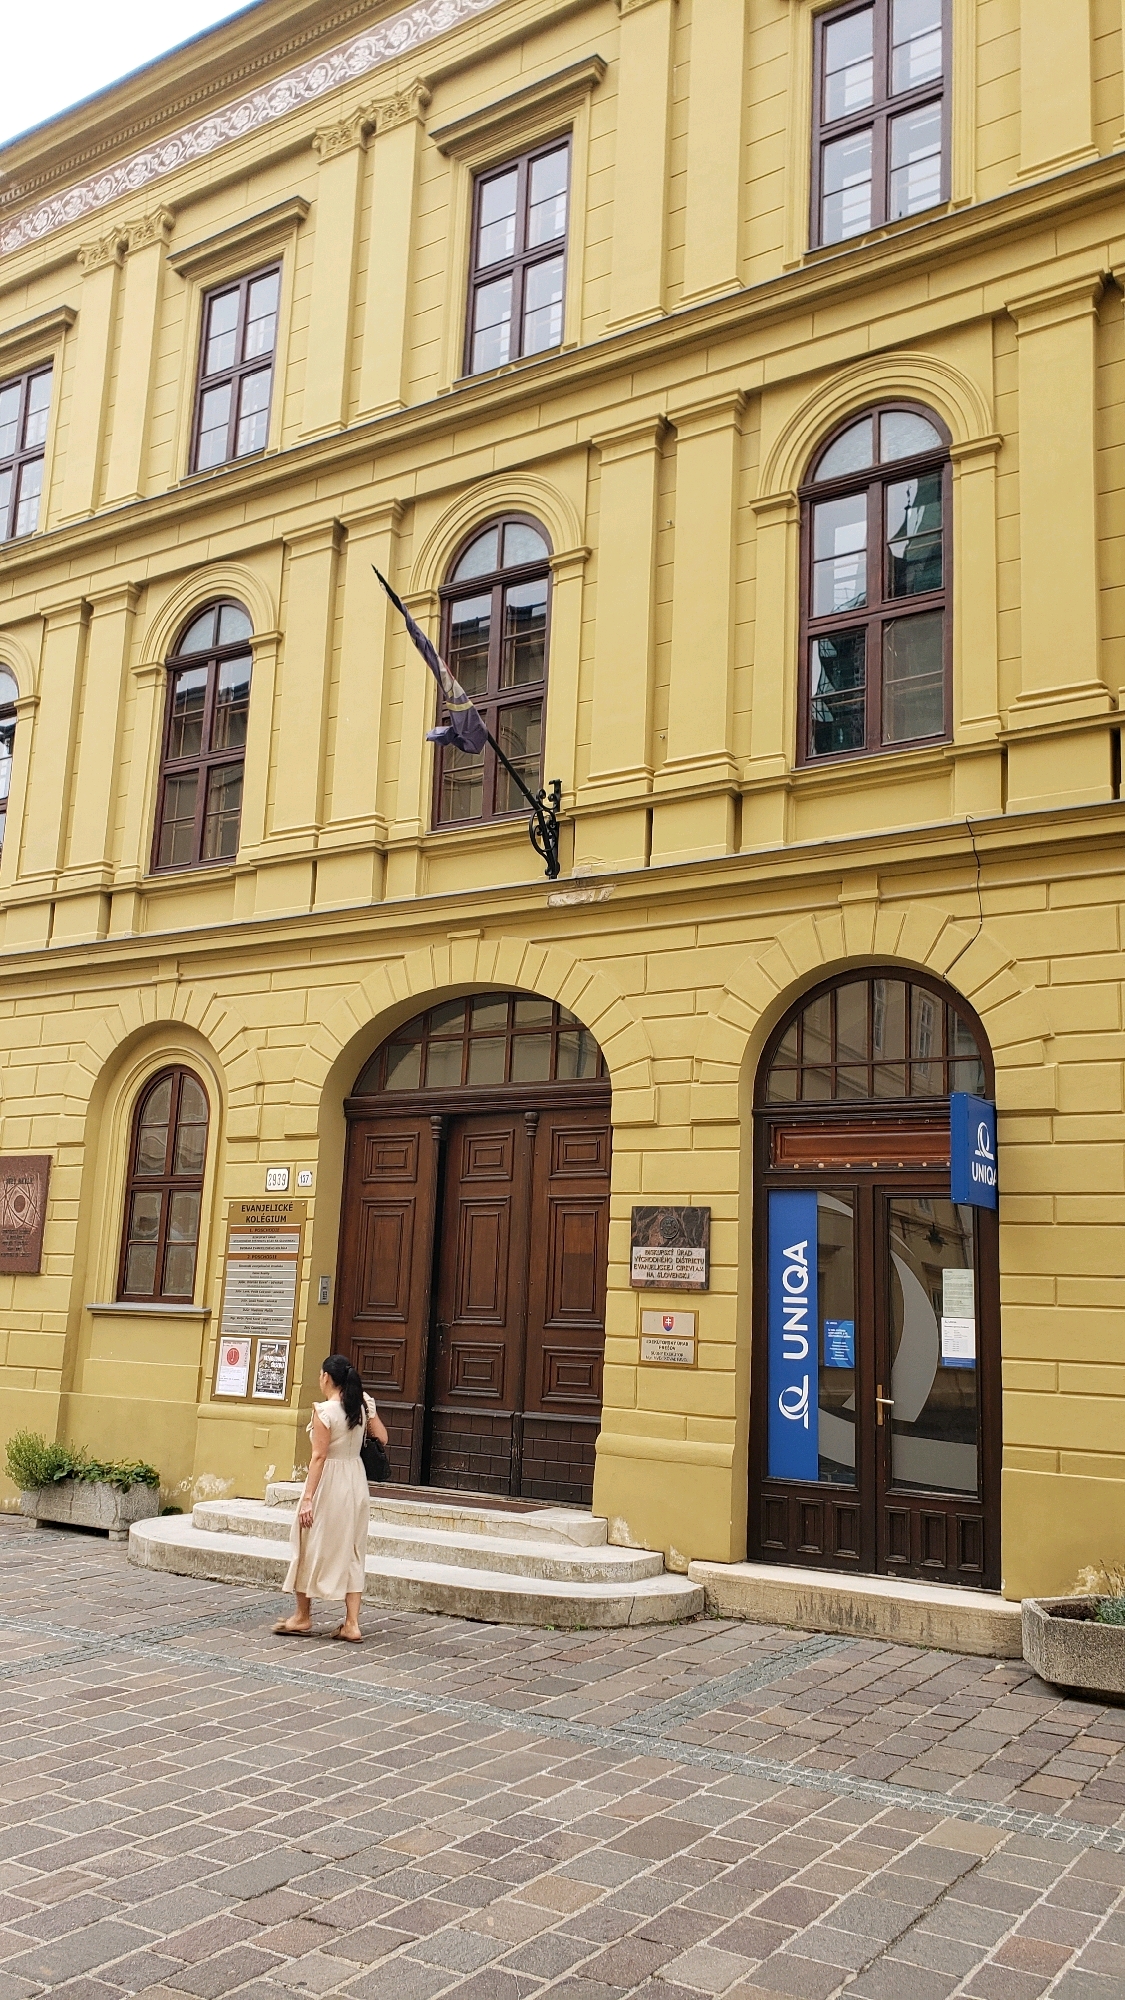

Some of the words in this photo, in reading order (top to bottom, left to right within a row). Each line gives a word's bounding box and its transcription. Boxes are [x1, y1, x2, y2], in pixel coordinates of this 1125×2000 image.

[268, 1173, 287, 1186] 2939
[241, 1201, 294, 1213] EVANJELICKÉ
[245, 1213, 287, 1223] KOLÉGIUM
[677, 1249, 693, 1257] ÚRAD
[634, 1255, 673, 1264] VÝCHODNÉHO
[633, 1263, 673, 1271] EVANJELICKEJ
[646, 1271, 655, 1279] NA
[782, 1239, 809, 1360] UNIQA
